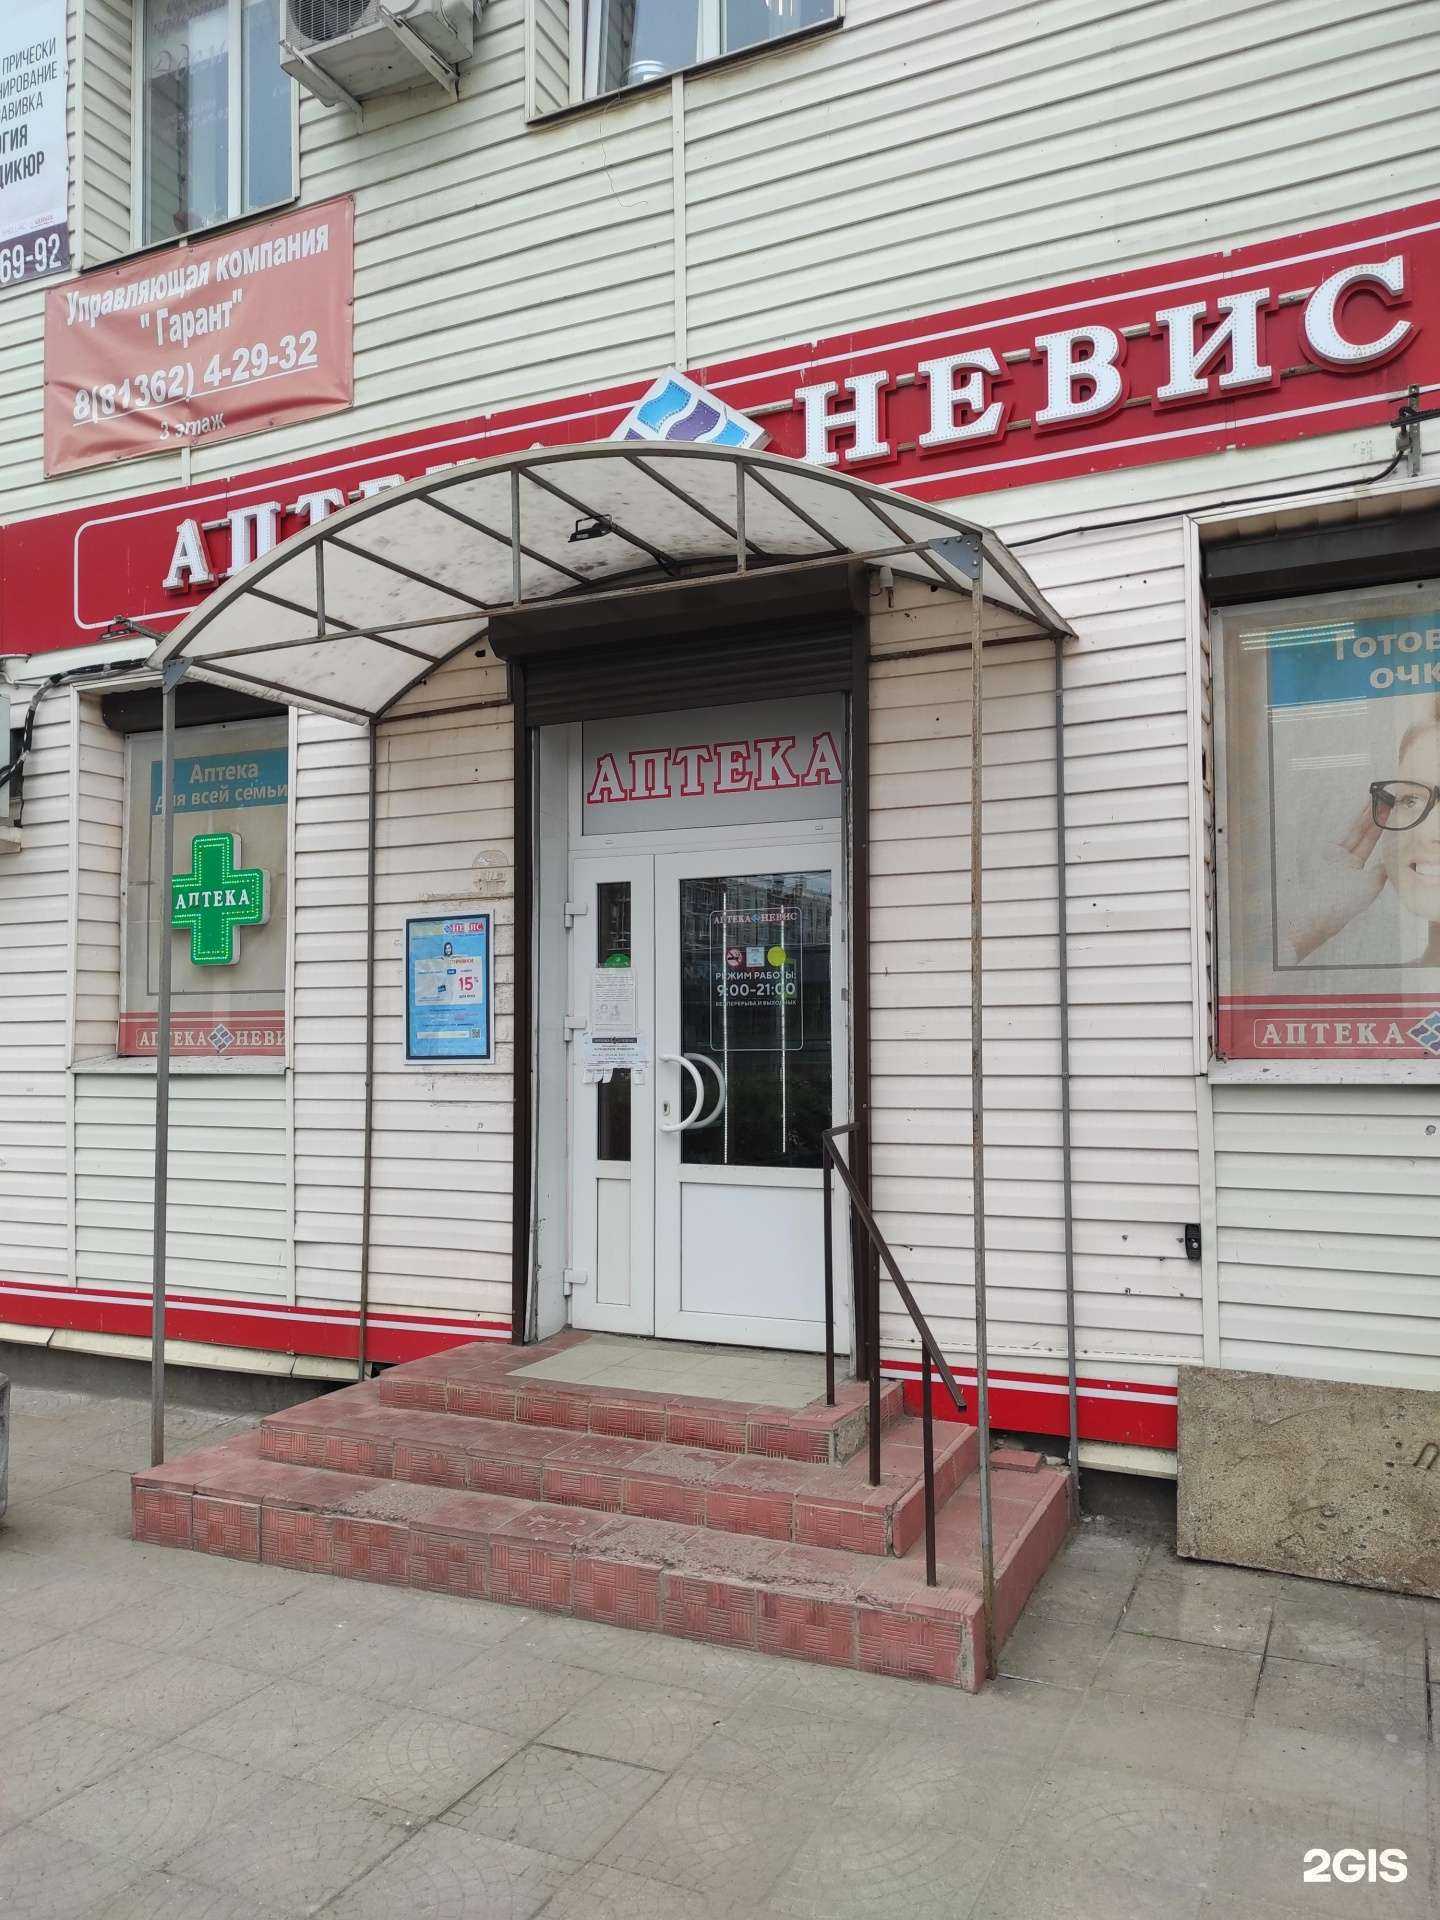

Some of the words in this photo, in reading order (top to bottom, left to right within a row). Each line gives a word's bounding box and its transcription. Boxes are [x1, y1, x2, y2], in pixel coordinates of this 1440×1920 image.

[2, 37, 56, 75] ПРИЧЕСКИ
[0, 91, 43, 123] АВИВКА
[0, 124, 28, 154] ГИЯ
[66, 259, 210, 328] Управляющая
[216, 224, 329, 282] компания
[796, 255, 1414, 466] НЕВИС
[74, 362, 194, 424] 8(81362)
[203, 330, 318, 386] 4-29-32
[160, 420, 170, 440] 3
[175, 411, 227, 437] этаж
[1335, 628, 1440, 661] Готов
[1369, 661, 1440, 689] очк
[189, 763, 259, 784] Аптека
[587, 731, 842, 804] АПТЕКА
[191, 785, 229, 806] всей
[175, 889, 250, 909] АПТЕКА
[458, 976, 474, 991] 15
[236, 1029, 286, 1046] НЕВИ
[1261, 1022, 1406, 1045] АПТЕКА
